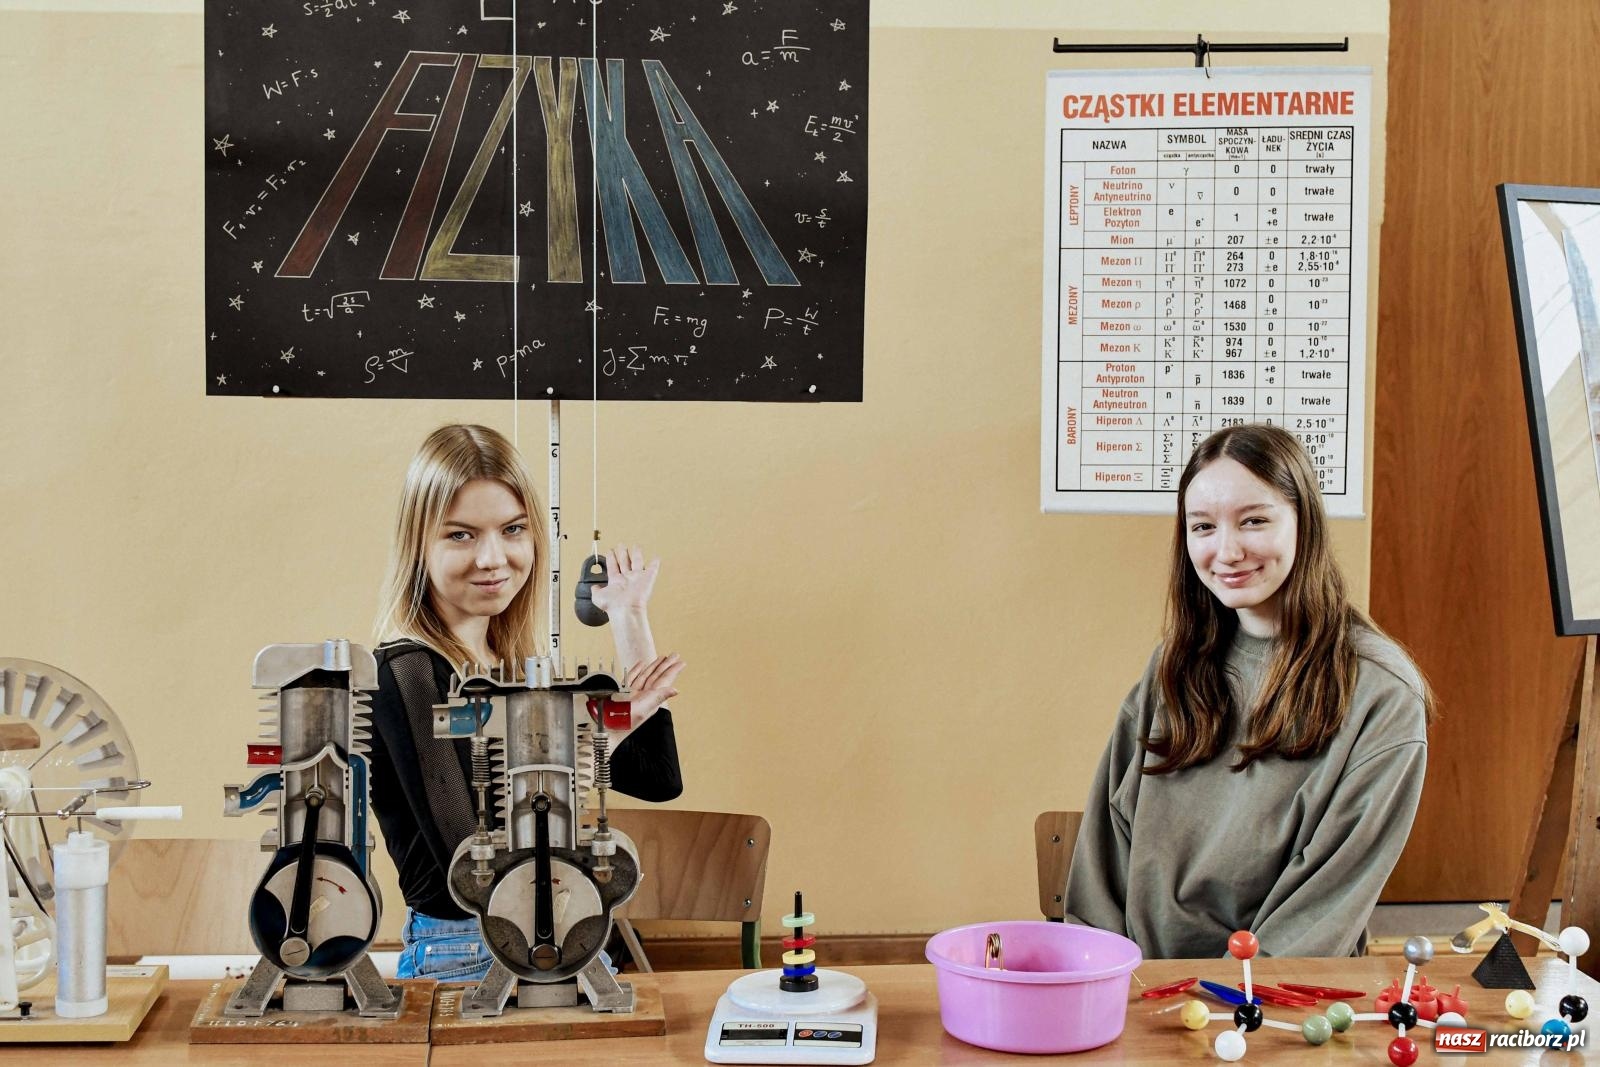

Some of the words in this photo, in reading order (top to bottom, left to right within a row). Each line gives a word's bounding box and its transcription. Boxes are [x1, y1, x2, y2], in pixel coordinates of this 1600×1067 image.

[1063, 93, 1164, 123] CZĄSTKI
[1173, 91, 1354, 116] ELEMENTARNE
[1167, 134, 1206, 144] SYMBOL
[1327, 130, 1351, 139] CZAS
[1092, 140, 1127, 150] NAZWA
[274, 50, 802, 286] FIZYKA
[1110, 166, 1136, 175] Foton
[1305, 165, 1335, 174] trwały
[1103, 181, 1143, 190] Neutrino
[1305, 187, 1335, 196] trwałe
[1093, 192, 1152, 202] Antyneutrino
[1070, 185, 1079, 226] LEPTONY
[1103, 207, 1142, 217] Elektron
[1304, 212, 1334, 222] trwałe
[1104, 218, 1140, 228] Pozyton
[1110, 236, 1134, 245] Mion
[1227, 236, 1244, 244] 207
[1227, 252, 1244, 260] 264
[1101, 256, 1132, 266] Mezon
[1227, 263, 1244, 272] 273
[1102, 277, 1132, 287] Mezon
[1224, 279, 1247, 288] 1072
[1069, 285, 1079, 325] MEZONY
[1102, 299, 1132, 309] Mezon
[1224, 301, 1246, 309] 1468
[1101, 322, 1131, 331] Mezon
[1224, 322, 1246, 331] 1530
[1226, 338, 1242, 346] 974
[1101, 343, 1131, 352] Mezon
[1225, 349, 1242, 357] 967
[1106, 363, 1136, 372] Proton
[1096, 374, 1145, 384] Antyproton
[1222, 370, 1245, 379] 1836
[1302, 370, 1331, 379] trwałe
[1102, 389, 1138, 398] Neutron
[1093, 399, 1147, 410] Antyneutron
[1222, 397, 1244, 405] 1839
[1301, 397, 1331, 405] trwałe
[1096, 416, 1133, 426] Hiperon
[1067, 407, 1076, 445] BARONY
[1096, 442, 1133, 452] Hiperon
[1095, 473, 1131, 483] Hiperon
